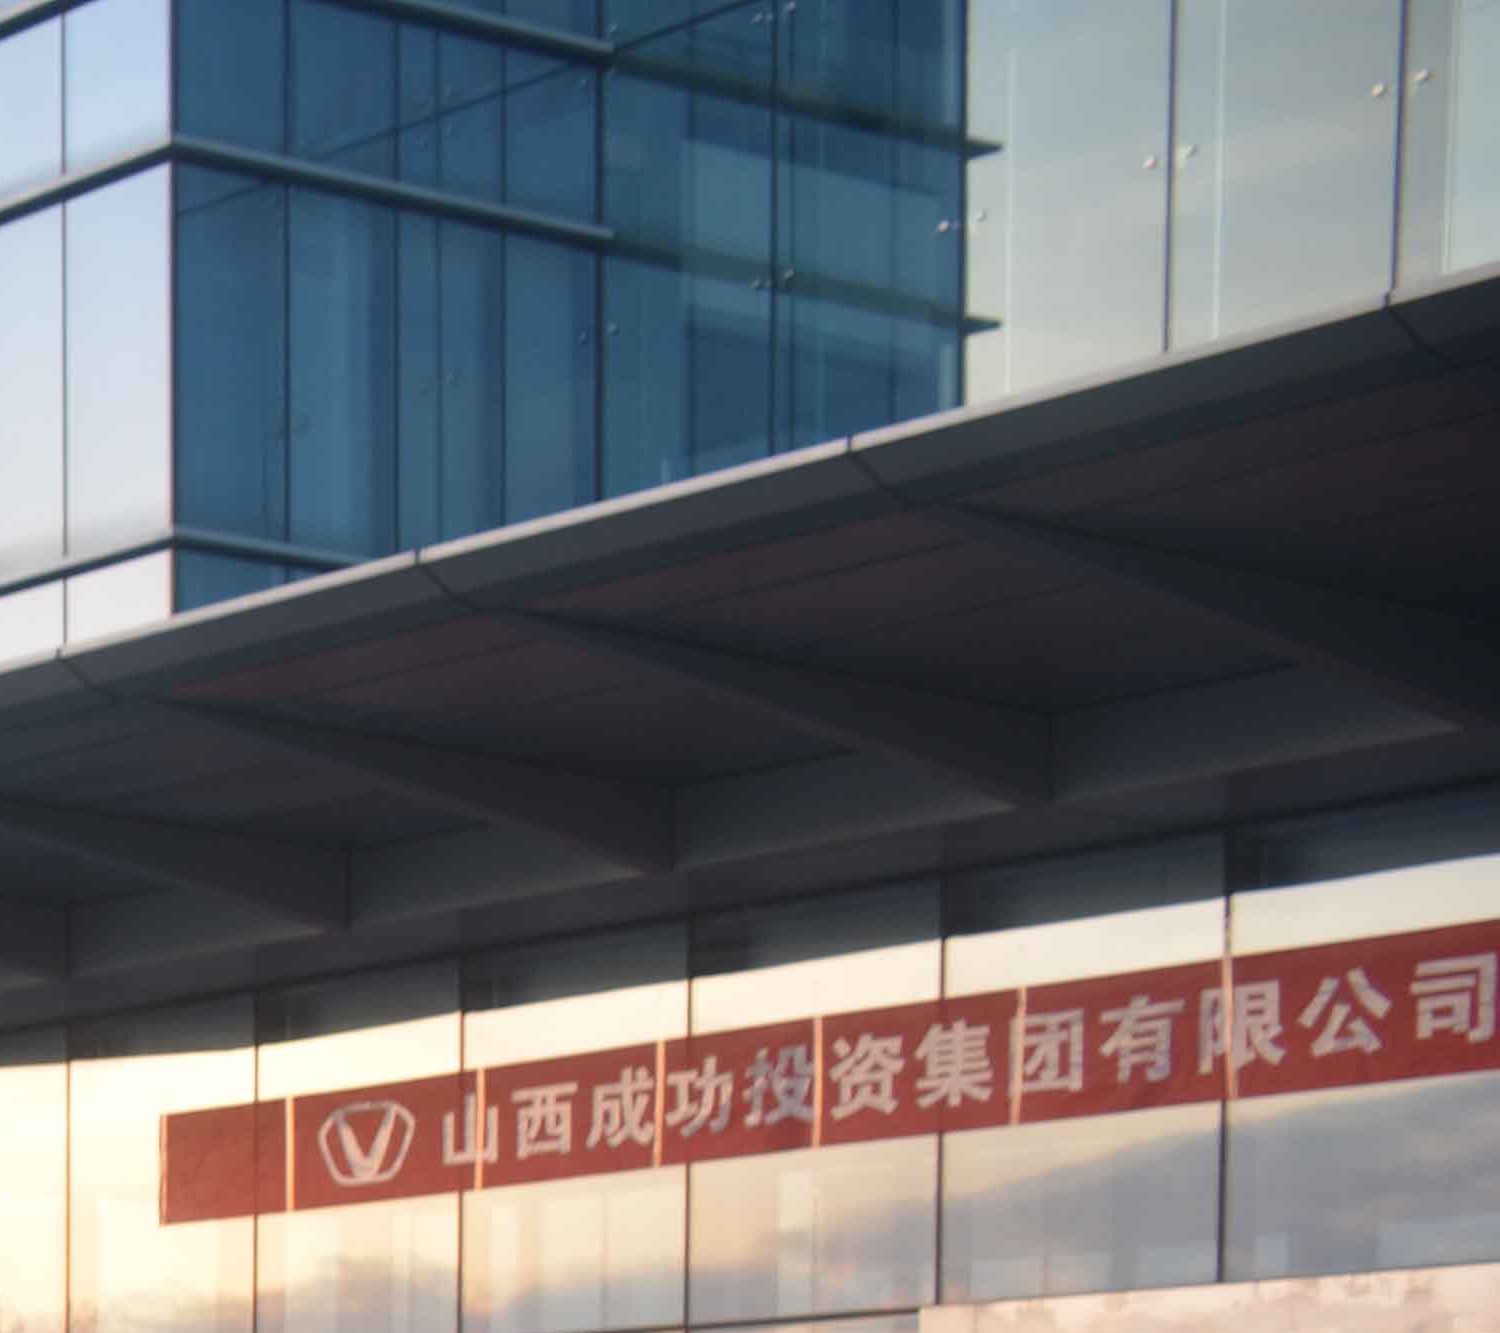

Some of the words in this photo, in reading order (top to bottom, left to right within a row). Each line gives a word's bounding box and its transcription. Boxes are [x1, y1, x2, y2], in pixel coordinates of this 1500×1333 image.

[442, 952, 1498, 1167] 山西成功投资集团有限公司
